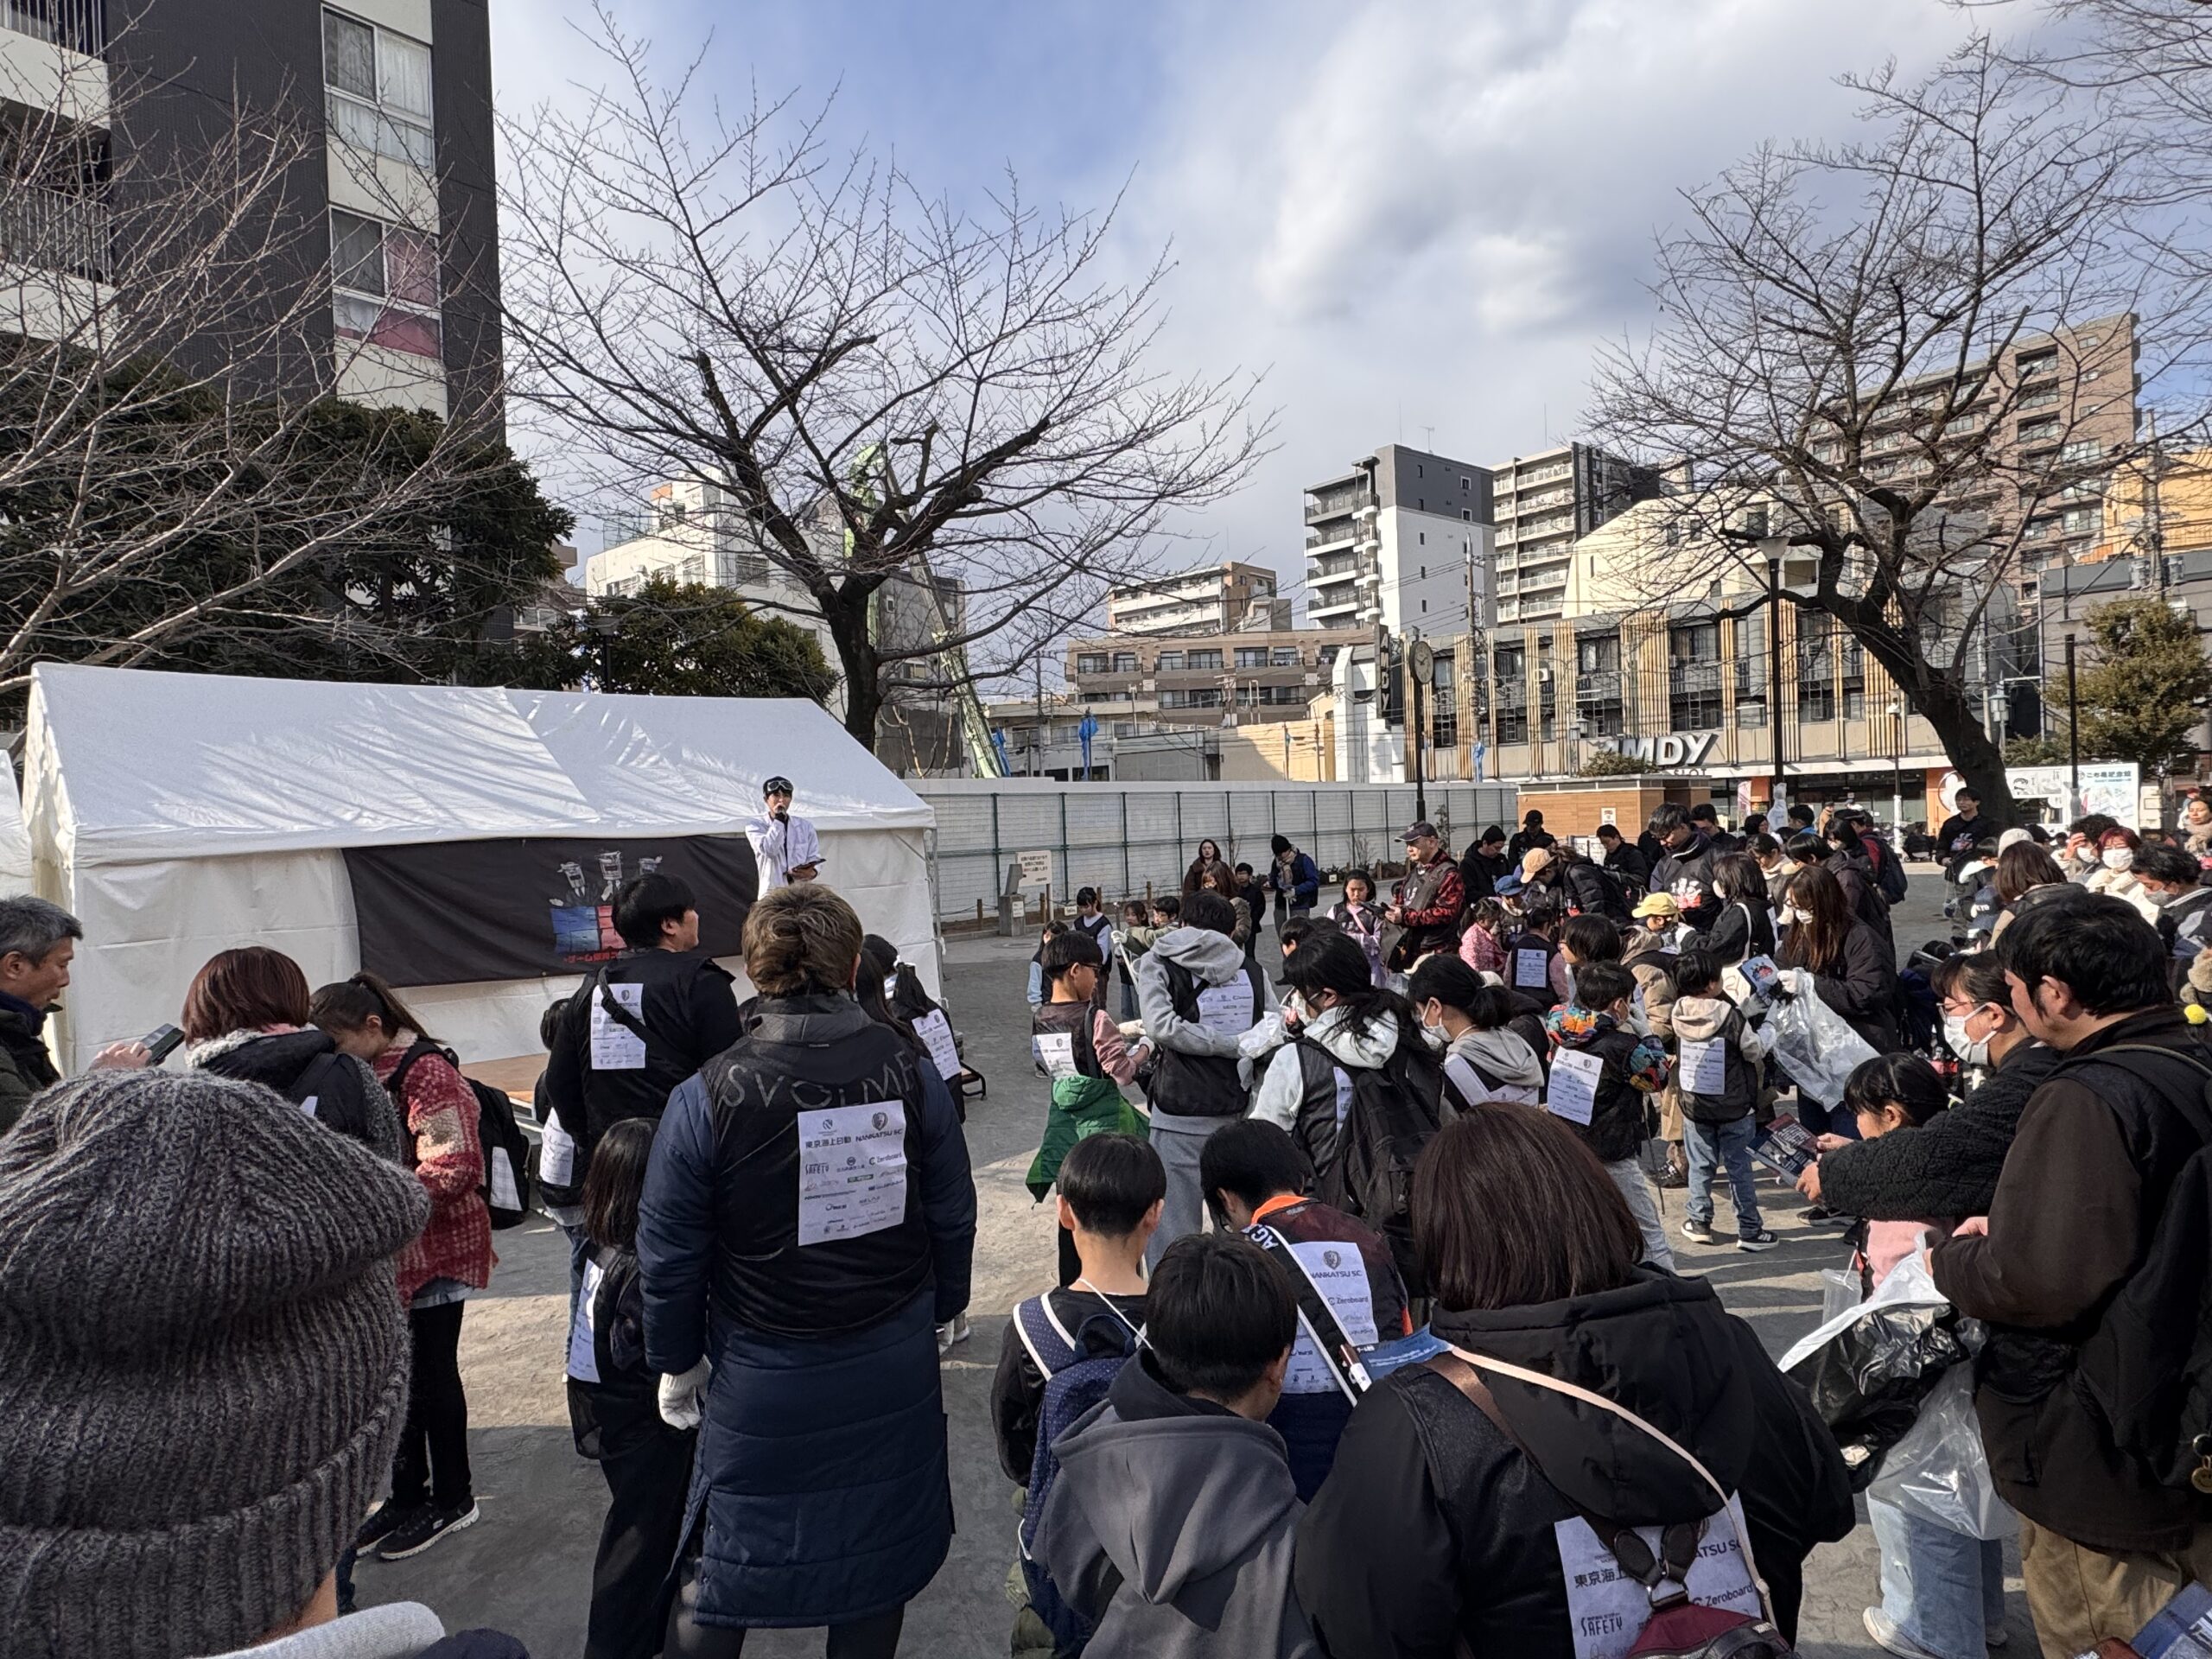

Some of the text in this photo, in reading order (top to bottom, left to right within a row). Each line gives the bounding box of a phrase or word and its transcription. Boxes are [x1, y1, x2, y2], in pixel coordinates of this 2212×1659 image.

[1381, 632, 1389, 711] AMDY
[1705, 1582, 1754, 1607] Zeroboard
[1580, 1616, 1623, 1637] SAFETY
